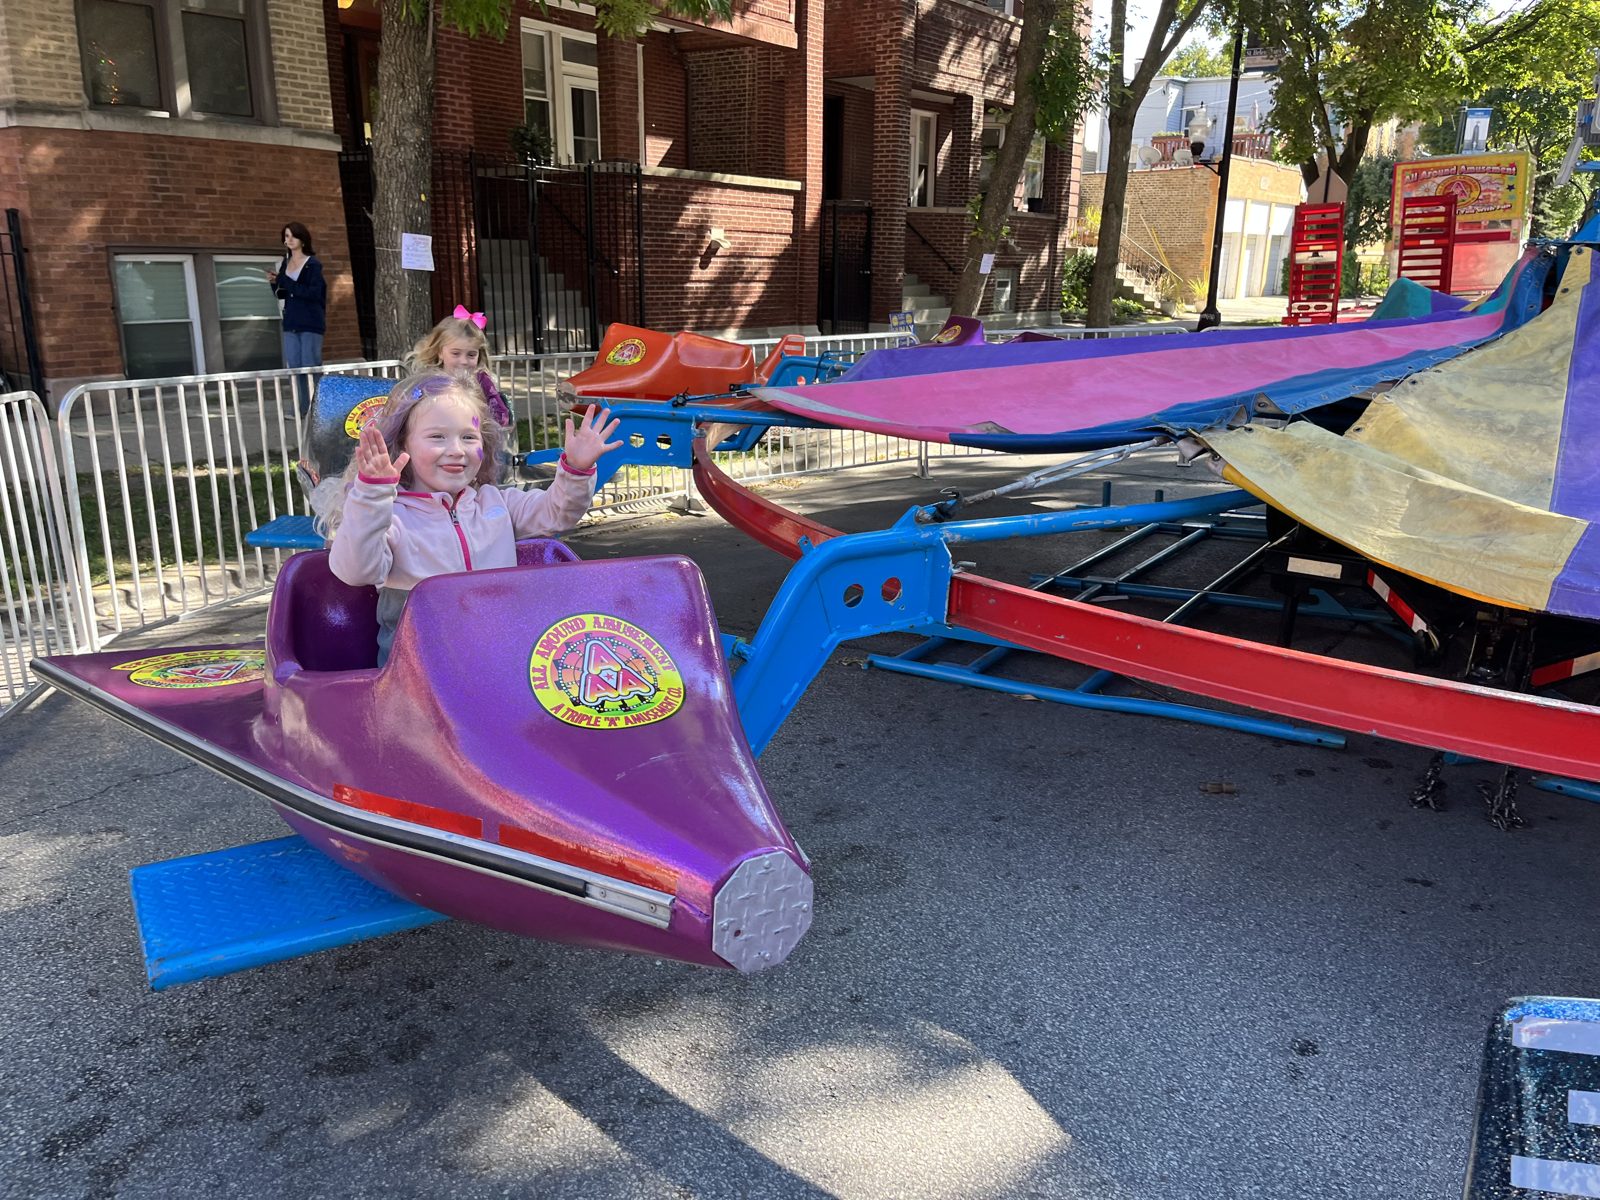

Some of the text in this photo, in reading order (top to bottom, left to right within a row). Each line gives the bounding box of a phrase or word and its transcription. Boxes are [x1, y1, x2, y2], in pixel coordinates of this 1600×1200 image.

[1404, 164, 1517, 183] All Around Amusement
[532, 616, 676, 690] ALL AROUND AMUSEMENT
[550, 702, 562, 715] A
[561, 708, 601, 727] TRIPLE
[624, 698, 676, 726] AMUSEMENT
